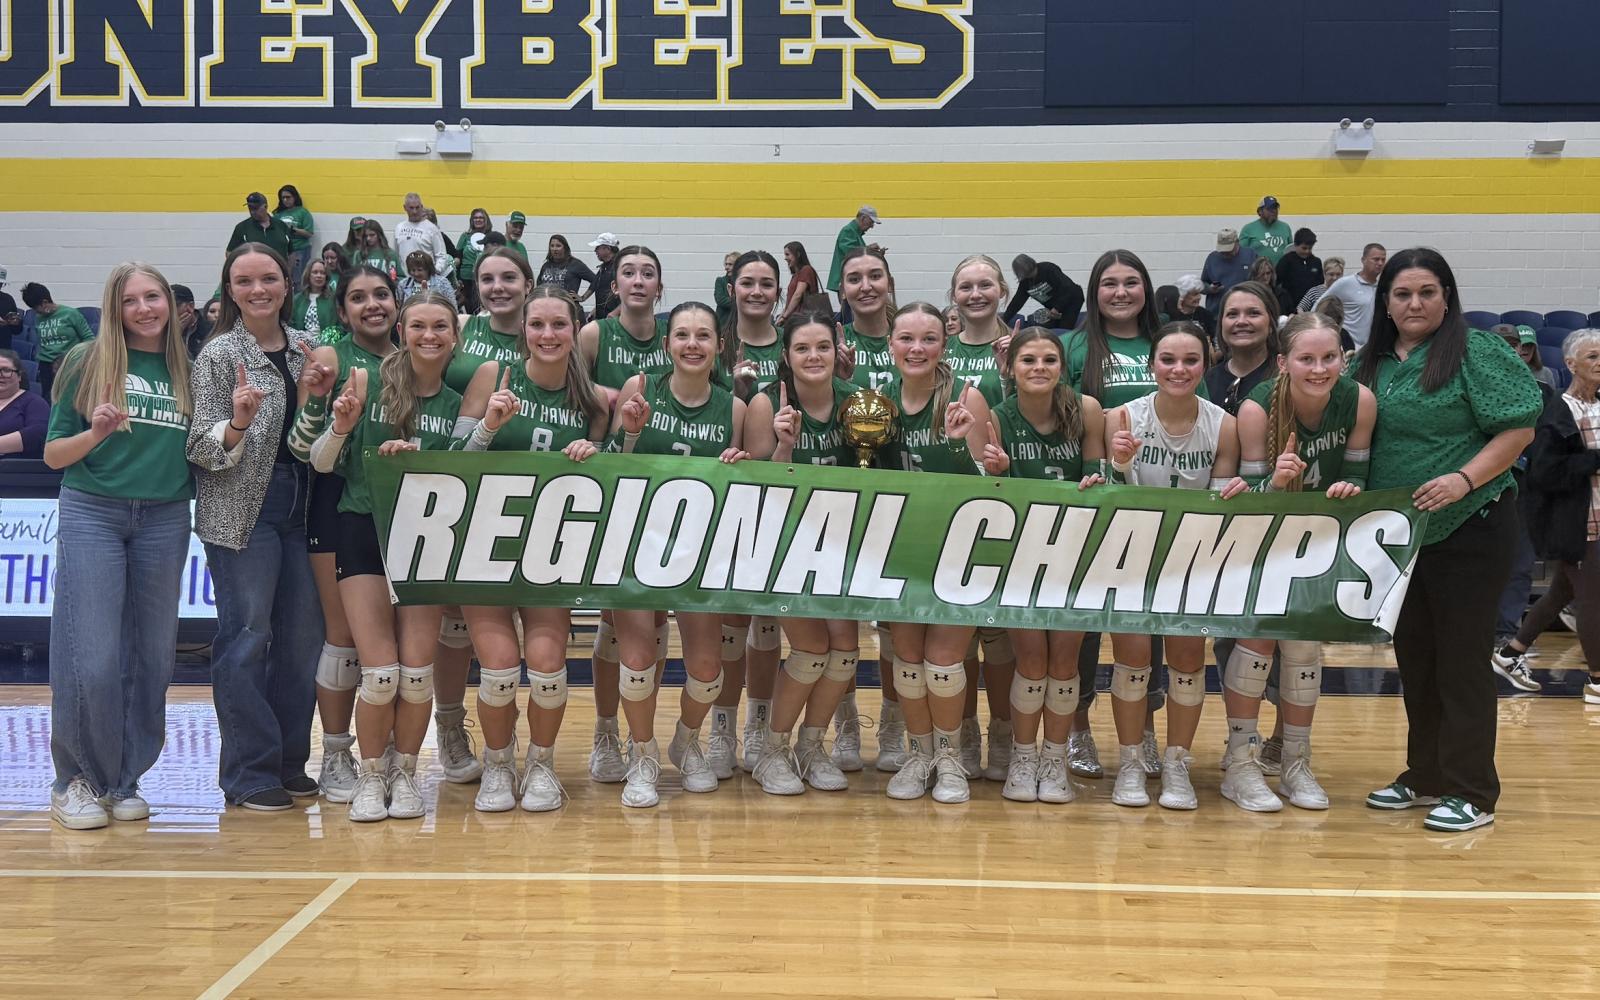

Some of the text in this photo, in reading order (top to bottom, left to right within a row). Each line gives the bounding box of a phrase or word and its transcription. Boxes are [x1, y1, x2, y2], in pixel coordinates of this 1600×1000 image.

[40, 319, 61, 329] GAME
[41, 328, 58, 338] DAY
[462, 338, 494, 359] LADY
[638, 349, 673, 369] HAWK
[540, 404, 585, 429] HAWKS
[644, 411, 726, 443] ADY HAWKS
[529, 427, 554, 453] 8
[1010, 442, 1042, 461] LADY
[1136, 445, 1168, 467] ADY
[1303, 459, 1322, 489] 4
[384, 471, 1414, 622] REGIONAL CHAMPS
